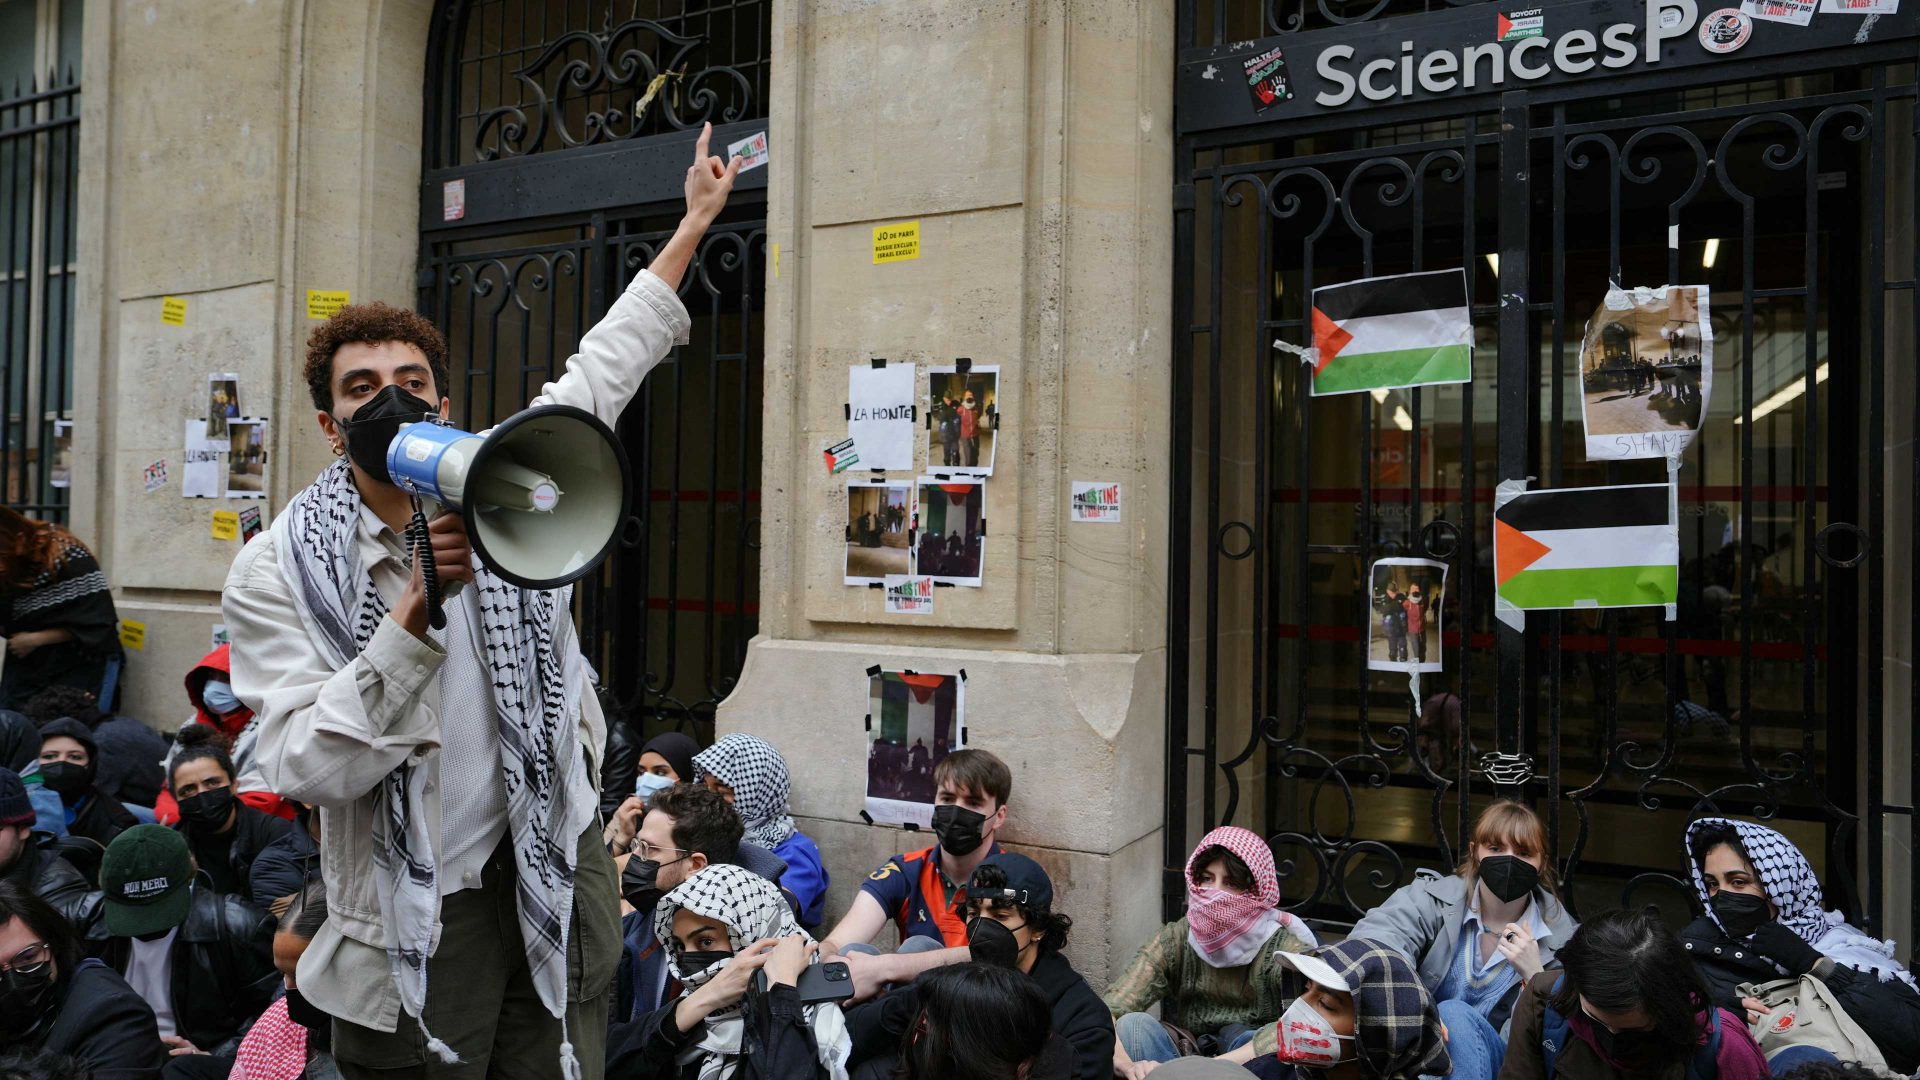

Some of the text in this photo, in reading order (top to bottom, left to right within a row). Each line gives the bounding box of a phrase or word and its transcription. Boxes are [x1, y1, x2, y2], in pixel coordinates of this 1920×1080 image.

[1510, 8, 1542, 18] BOYCOTT
[1762, 6, 1787, 16] TAIRE
[1517, 19, 1541, 27] ISRAELI
[1504, 28, 1542, 38] APARTHEID
[1243, 52, 1271, 68] HALTE
[1315, 0, 1752, 107] SciencesP
[877, 231, 888, 241] JO
[898, 230, 915, 238] PARIS
[877, 251, 895, 259] ISRAEL
[895, 249, 912, 257] EXCLU
[311, 294, 321, 302] JO
[854, 405, 911, 421] LA HONTE
[1616, 433, 1689, 457] SHAME
[1073, 484, 1119, 504] PALESTINE
[888, 577, 932, 597] PALESTINE
[878, 802, 931, 821] SHAM
[124, 882, 140, 894] NON
[141, 877, 168, 891] MERCI
